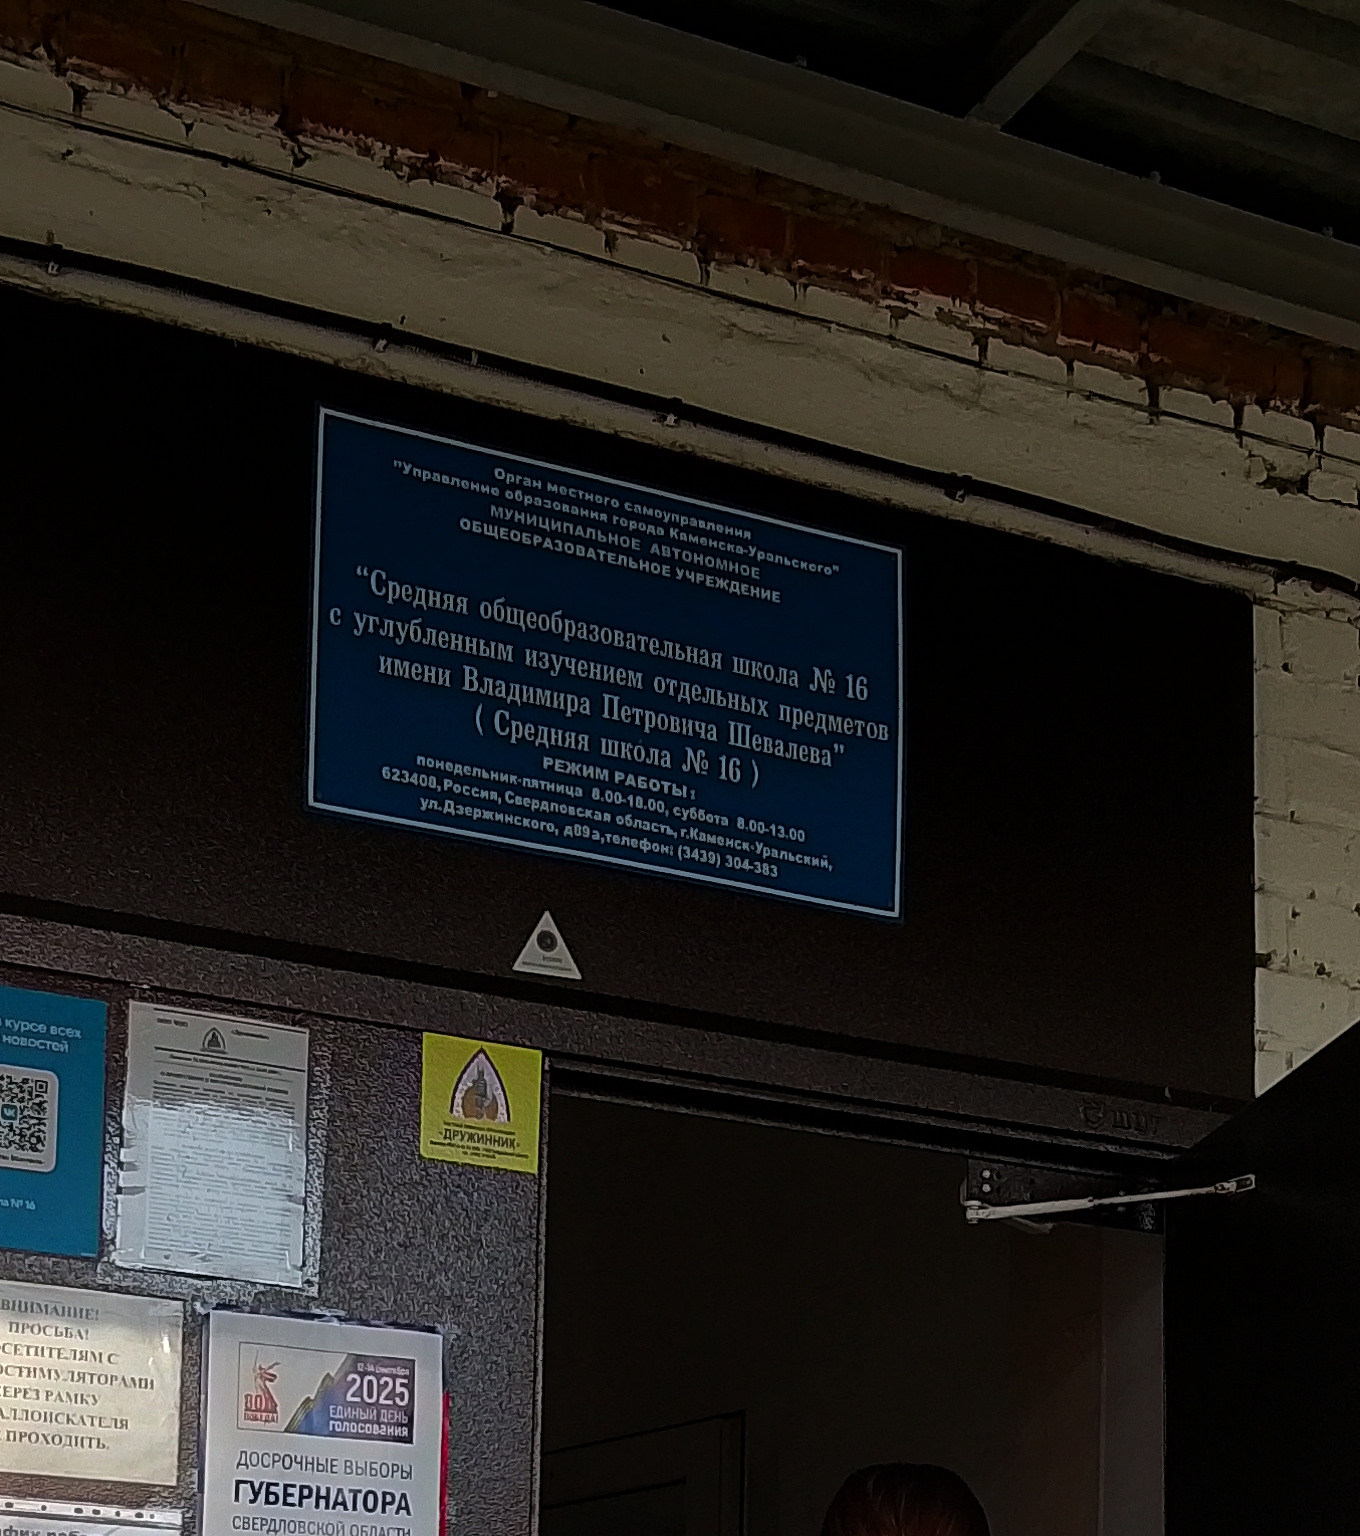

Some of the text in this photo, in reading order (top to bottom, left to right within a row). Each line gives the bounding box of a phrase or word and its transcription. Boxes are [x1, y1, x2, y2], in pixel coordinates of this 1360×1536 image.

[494, 467, 752, 540] Орган местного самоуправления
[504, 489, 608, 523] образования
[613, 513, 665, 537] города
[490, 504, 761, 580] МУНИЦИПАЛЬНОЕ АВТОНОМНОЕ
[458, 517, 782, 604] ОБЩЕОБРАЗОВАТЕЛЬНОЕ УЧРЕЖДЕНИЕ
[479, 596, 723, 670] общеобразовательная
[731, 655, 800, 689] школа
[809, 666, 836, 695] №
[845, 673, 868, 700] 16
[329, 606, 889, 741] с углубленным изучением отдельных предметов
[378, 654, 452, 687] имени
[462, 664, 591, 717] Владимира
[601, 692, 718, 742] Петровича
[494, 709, 590, 752] Средняя
[600, 737, 672, 769] школа
[682, 746, 709, 776] №
[719, 754, 741, 784] 16
[542, 755, 610, 783] РЕЖИМ
[416, 754, 584, 798] понедельник-пятница
[672, 804, 730, 827] суббота
[736, 816, 806, 843] 8.00-13.00
[504, 790, 612, 824] Свердловская
[725, 855, 779, 878] 304-383
[2, 1034, 69, 1053] новостей
[5, 1018, 47, 1033] курсе
[49, 1025, 82, 1039] всех
[0, 1298, 99, 1321] ВНИМАНИЕ!
[8, 1321, 89, 1341] ПРОСЬБА!
[107, 1352, 120, 1365] С
[45, 1389, 99, 1406] РАМКУ
[346, 1373, 409, 1407] 2025
[329, 1404, 409, 1424] ЕДИНЫЙ ДЕНЬ
[235, 1450, 413, 1480] ДОСРОЧНЫЕ ВЫБОРЫ
[233, 1479, 412, 1516] ГУБЕРНАТОРА
